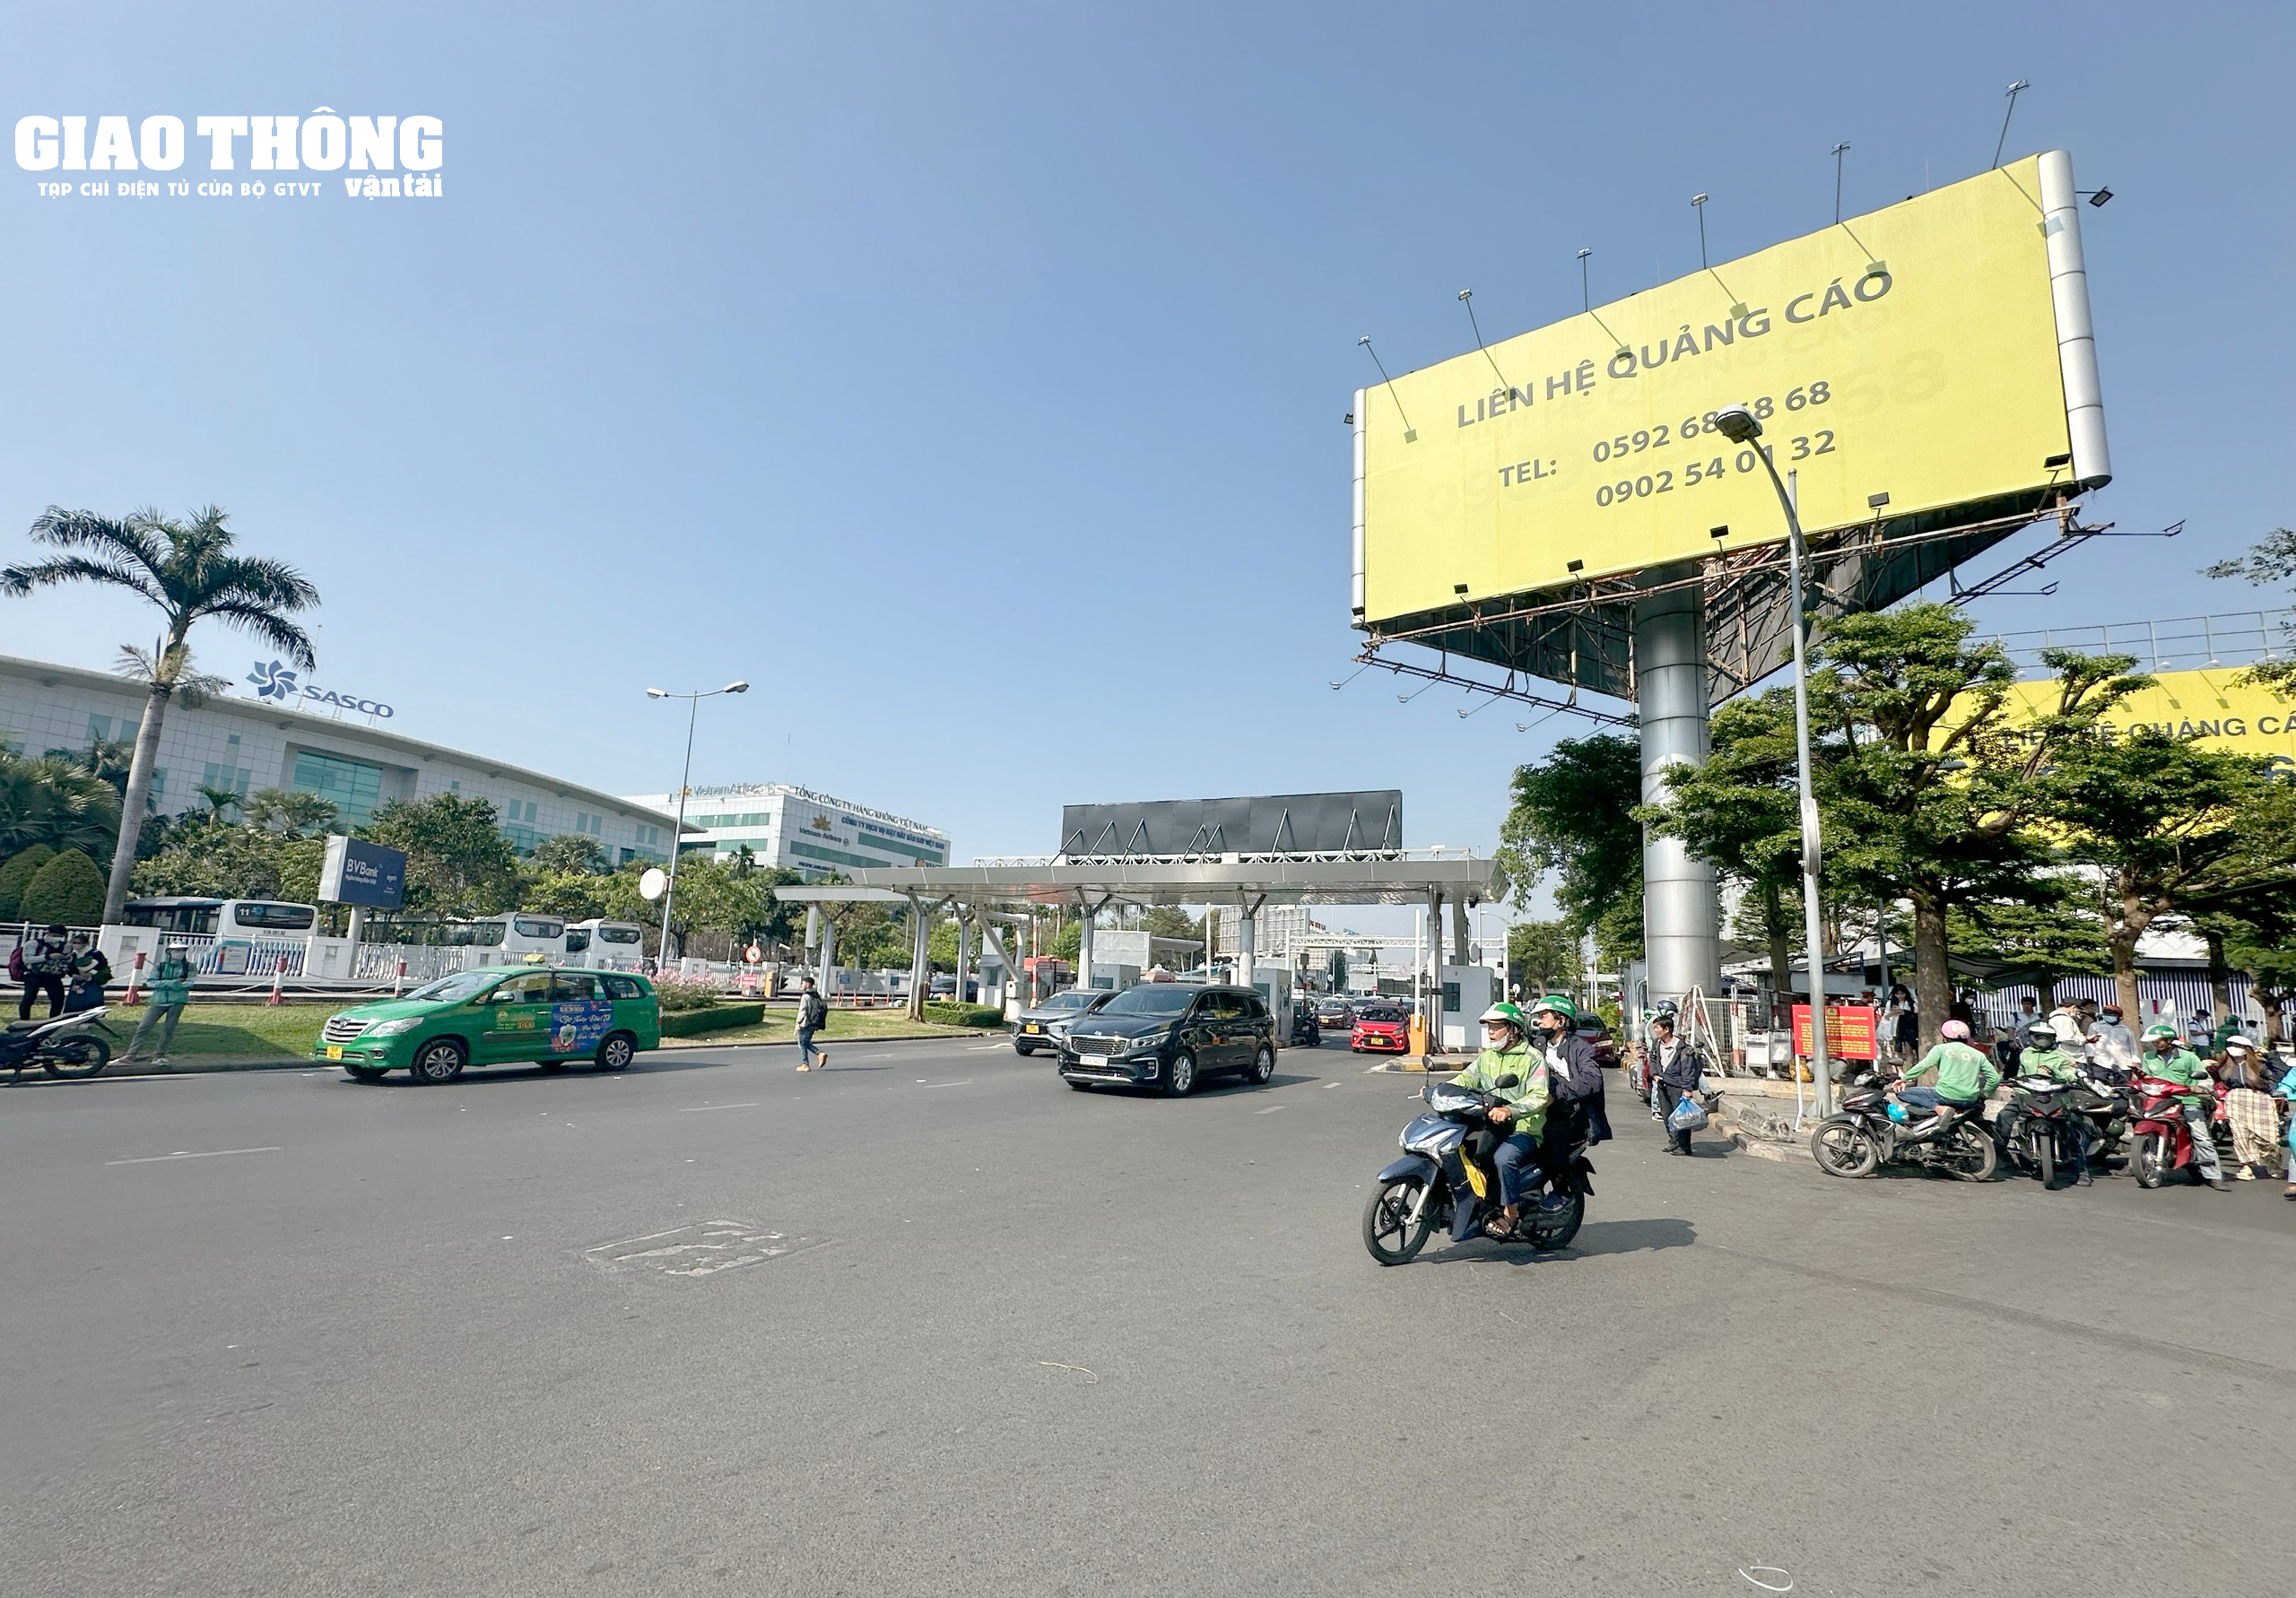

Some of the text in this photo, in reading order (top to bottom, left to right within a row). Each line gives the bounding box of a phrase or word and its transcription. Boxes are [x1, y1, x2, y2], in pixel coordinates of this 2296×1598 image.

[1457, 271, 1893, 428] LIÊN HỆ QUẢNG CÁO
[1592, 424, 1670, 462] 0592
[1680, 411, 1719, 439] 68
[1785, 380, 1831, 412] 68
[1499, 458, 1558, 487] TEL:
[1596, 471, 1674, 508] 0902
[1684, 456, 1726, 487] 54
[1790, 430, 1836, 461] 32
[303, 685, 394, 718] SASCO
[795, 784, 818, 801] TỔNG
[819, 793, 841, 807] CÔNG
[843, 801, 852, 810] TY
[853, 803, 874, 818] HÀNG
[913, 821, 928, 833] NAM
[799, 827, 822, 838] Vietnam
[346, 858, 378, 878] BVBank
[1554, 1000, 1571, 1010] Grab
